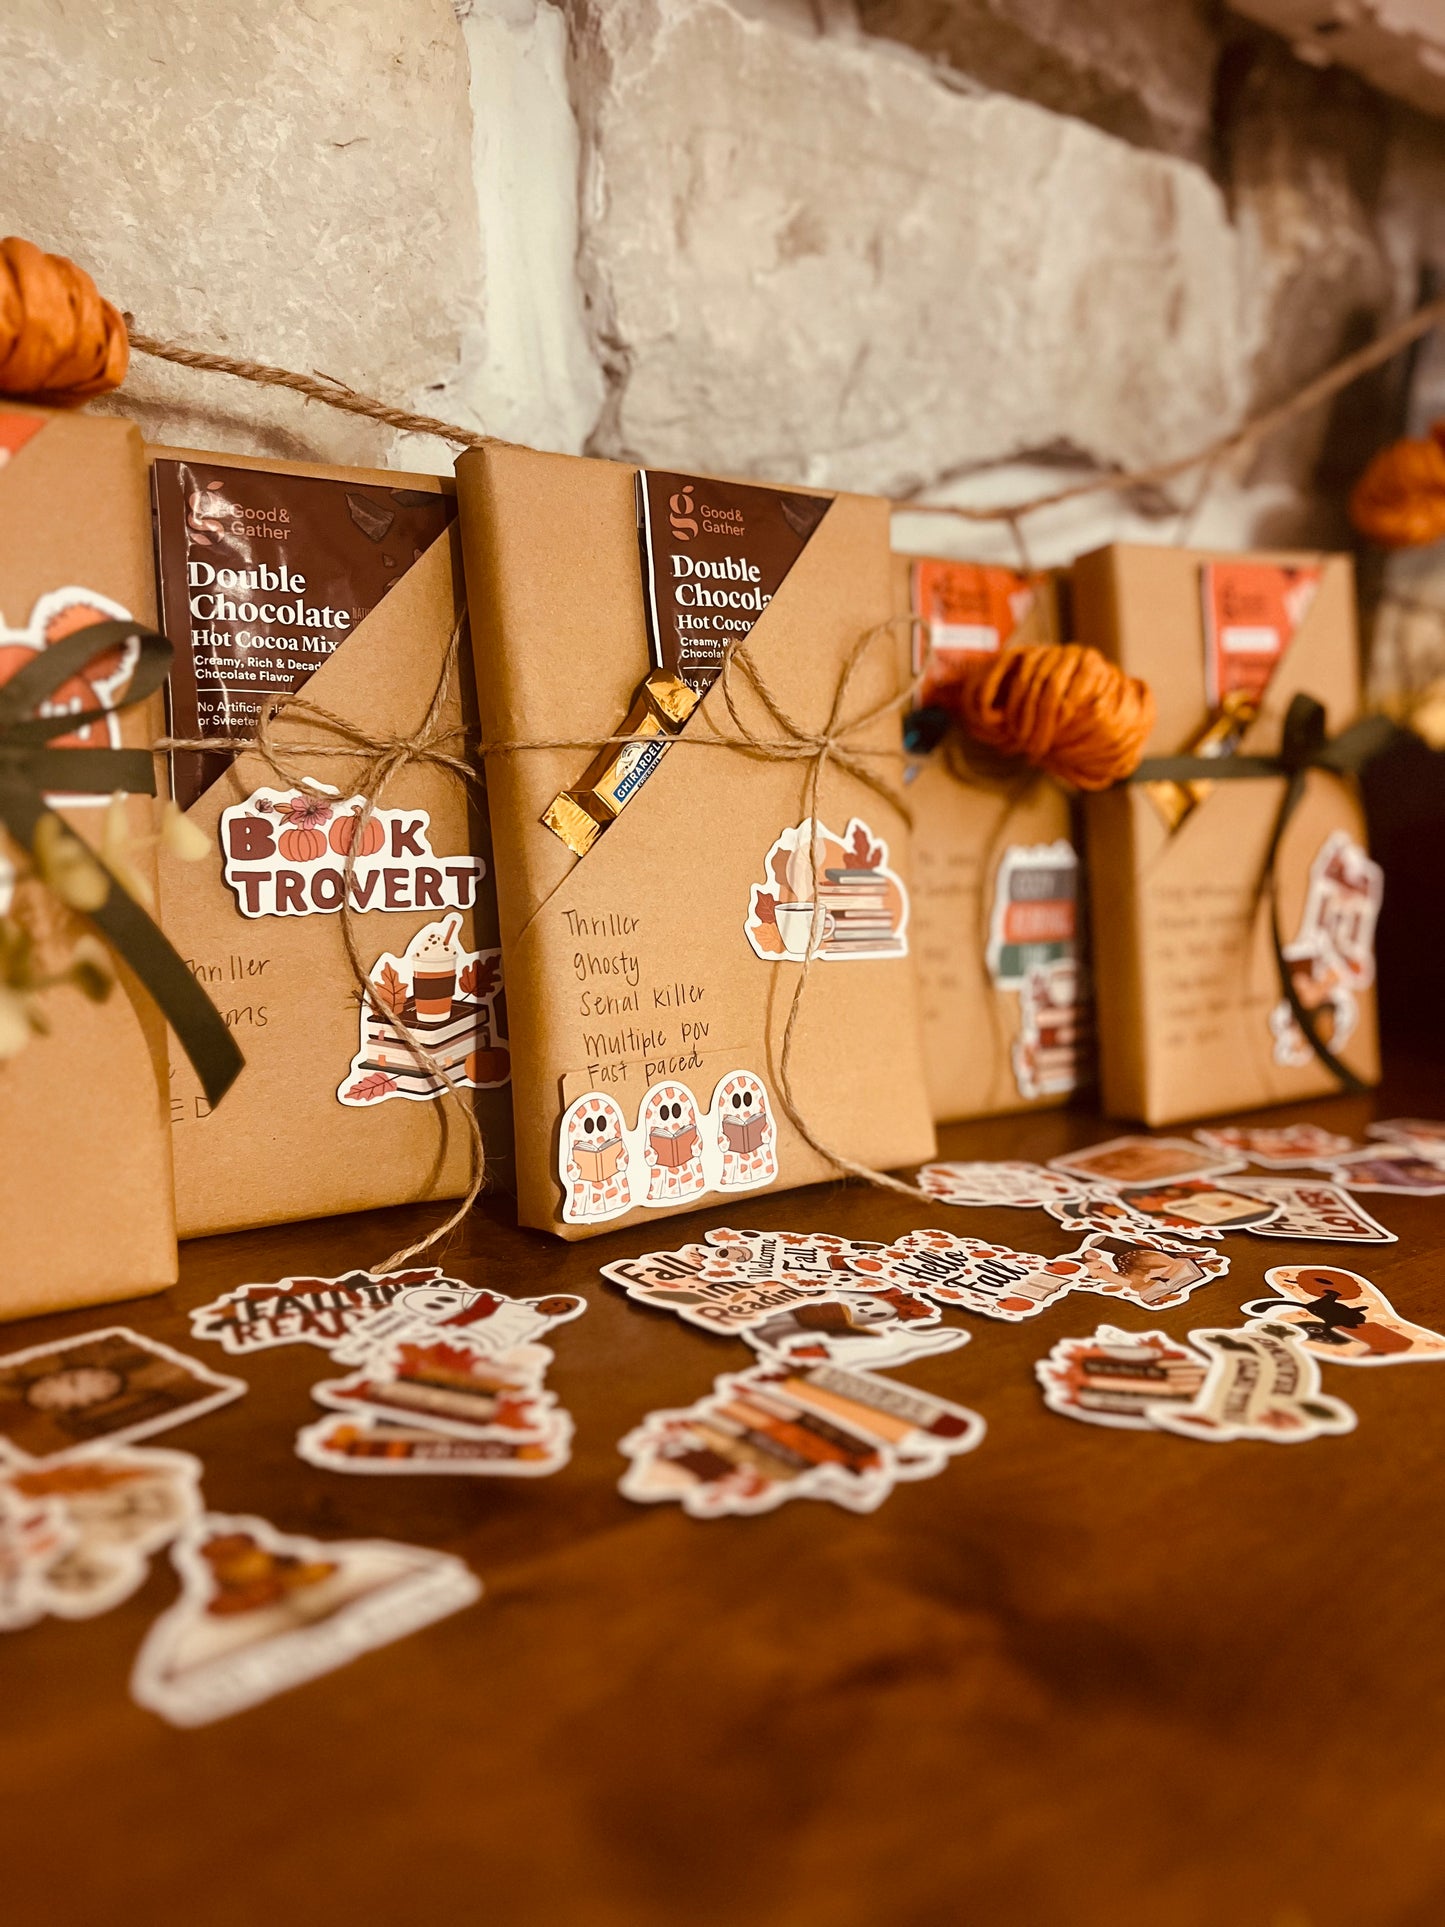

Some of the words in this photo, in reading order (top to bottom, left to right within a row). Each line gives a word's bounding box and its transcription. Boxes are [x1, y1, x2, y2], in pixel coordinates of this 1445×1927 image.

[701, 504, 734, 521] Good
[231, 521, 291, 540] Gather
[702, 520, 745, 537] Gather
[188, 561, 306, 594] Double
[671, 554, 761, 583] Double
[189, 594, 351, 630] Chocolate
[677, 614, 711, 630] Hot
[191, 629, 232, 648] Hot
[235, 631, 299, 652] Cocoa
[302, 636, 340, 654] Mix
[680, 637, 721, 648] Creamy,
[195, 655, 245, 668] Creamy,
[247, 657, 273, 668] Rich
[276, 659, 285, 669] &
[195, 669, 256, 681] Chocolate
[259, 671, 295, 682] Flavor
[197, 702, 214, 712] No
[198, 718, 211, 727] or
[231, 866, 480, 913] TROVERT
[562, 909, 640, 937] Thriller
[588, 1061, 628, 1090] Fast
[645, 1043, 704, 1087] paced
[614, 1254, 704, 1288] Fall
[748, 1238, 777, 1279] Welcome
[783, 1247, 832, 1273] Fall
[893, 1250, 969, 1282] Hello
[942, 1259, 1029, 1296] Fall
[240, 1290, 355, 1322] FALL
